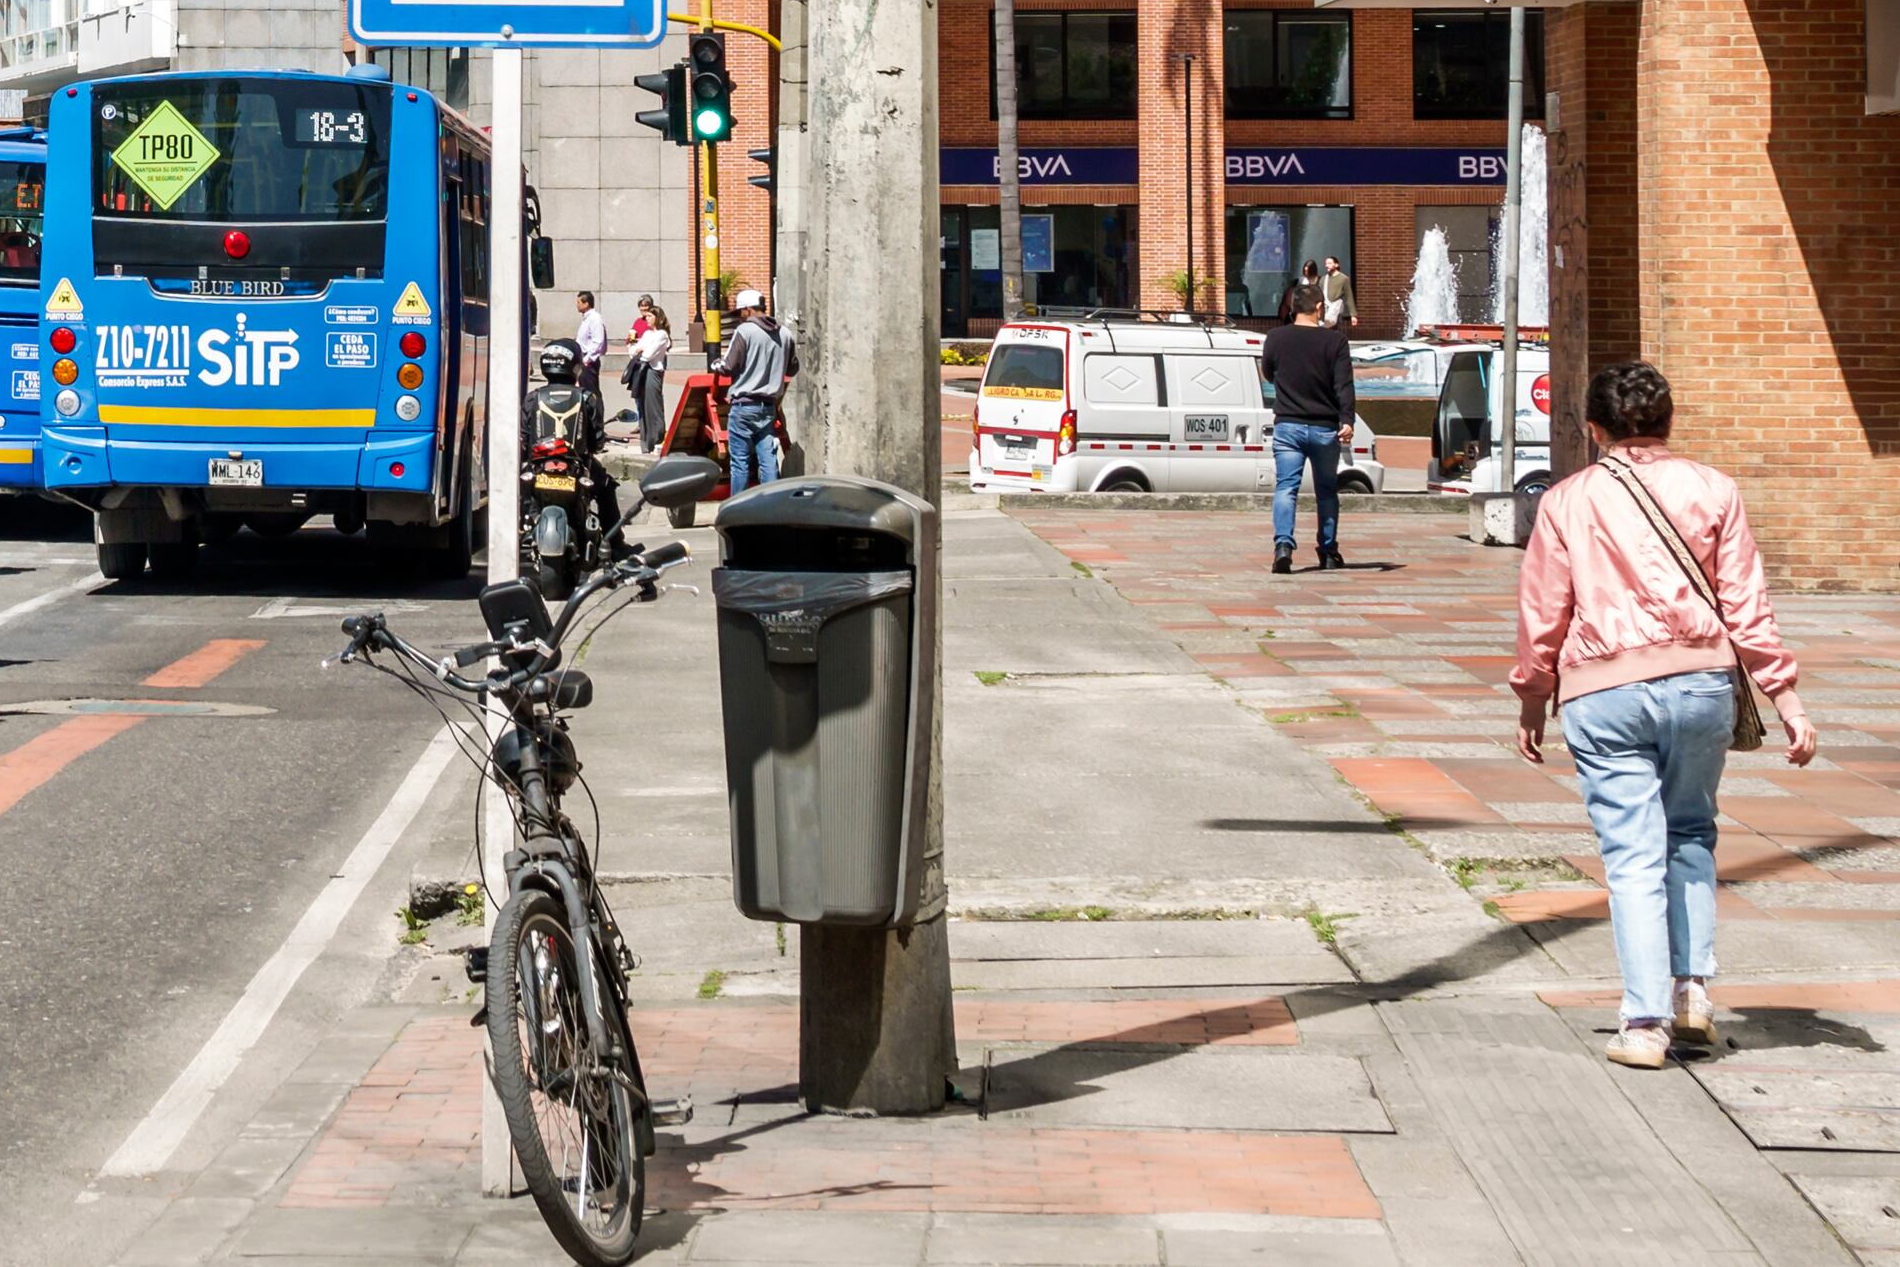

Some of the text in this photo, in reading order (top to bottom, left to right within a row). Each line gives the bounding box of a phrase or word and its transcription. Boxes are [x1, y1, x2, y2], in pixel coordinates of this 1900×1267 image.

[309, 111, 366, 142] 18-3
[139, 134, 193, 160] TP80
[1225, 153, 1305, 178] BBVA
[190, 281, 285, 295] BLUE BIRD
[45, 312, 84, 321] PUNTO CIEGO
[392, 317, 432, 325] PUNTO CIEGO
[340, 334, 363, 344] CEDA
[95, 325, 190, 369] Z10-7211
[334, 344, 369, 354] EL PASO
[98, 376, 135, 387] Consorcio
[136, 376, 165, 389] Express
